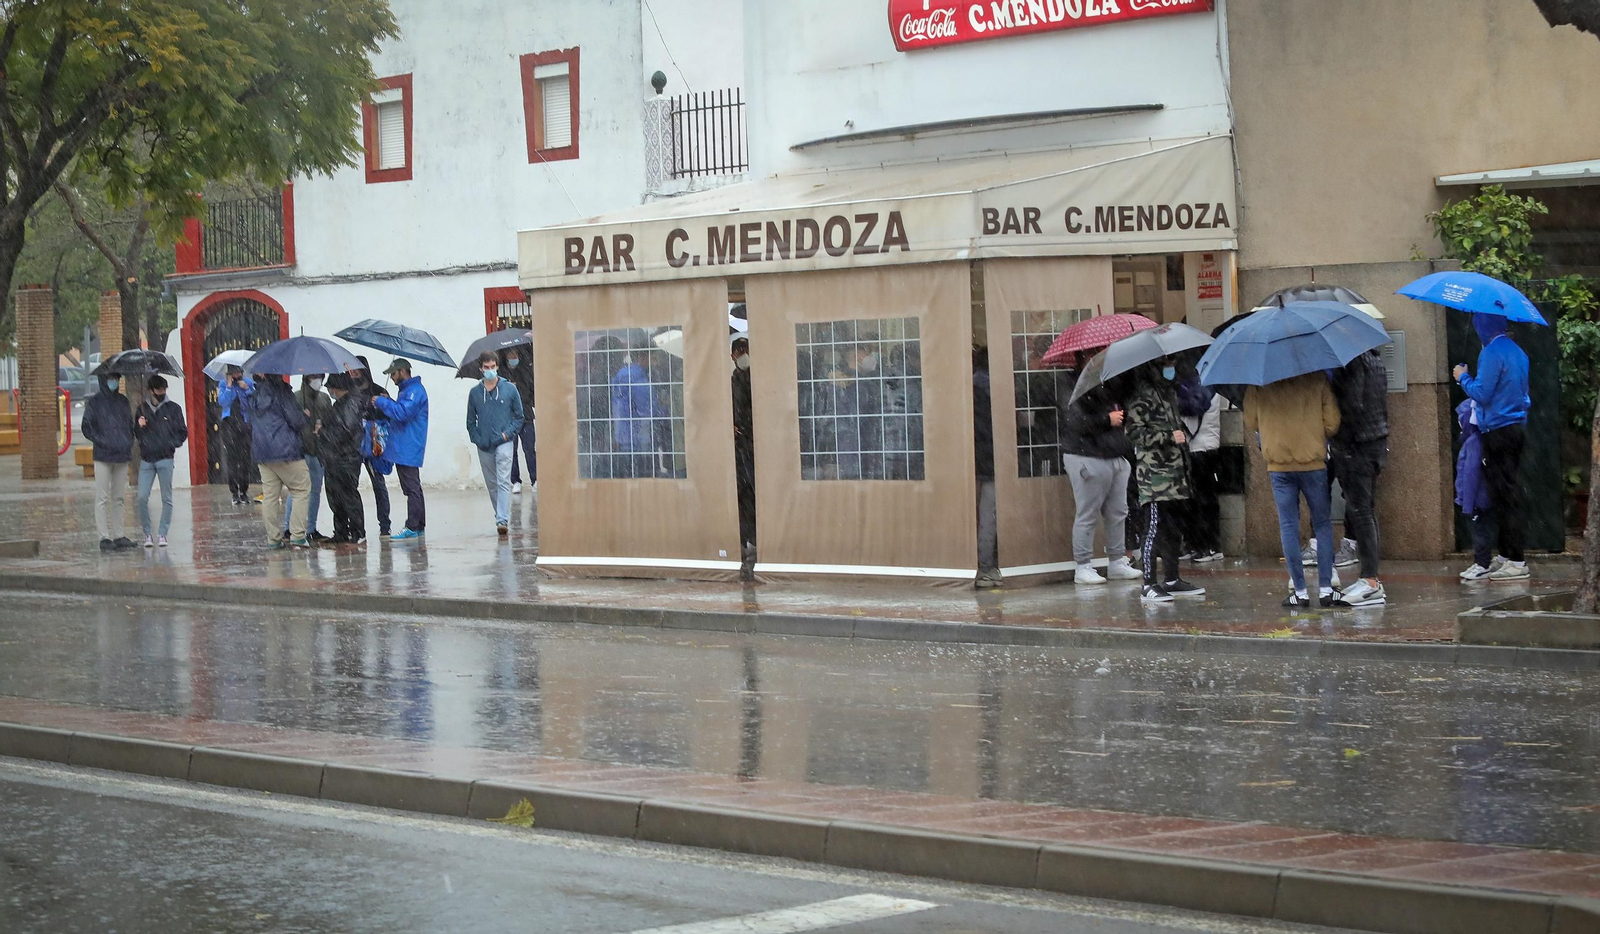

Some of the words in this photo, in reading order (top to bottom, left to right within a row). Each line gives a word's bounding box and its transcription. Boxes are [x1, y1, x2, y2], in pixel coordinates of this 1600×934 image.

[899, 7, 957, 42] Coca-Cola
[982, 207, 1042, 235] BAR
[1064, 203, 1230, 234] C.MENDOZA
[564, 233, 636, 275] BAR
[665, 211, 911, 268] C.MENDOZA
